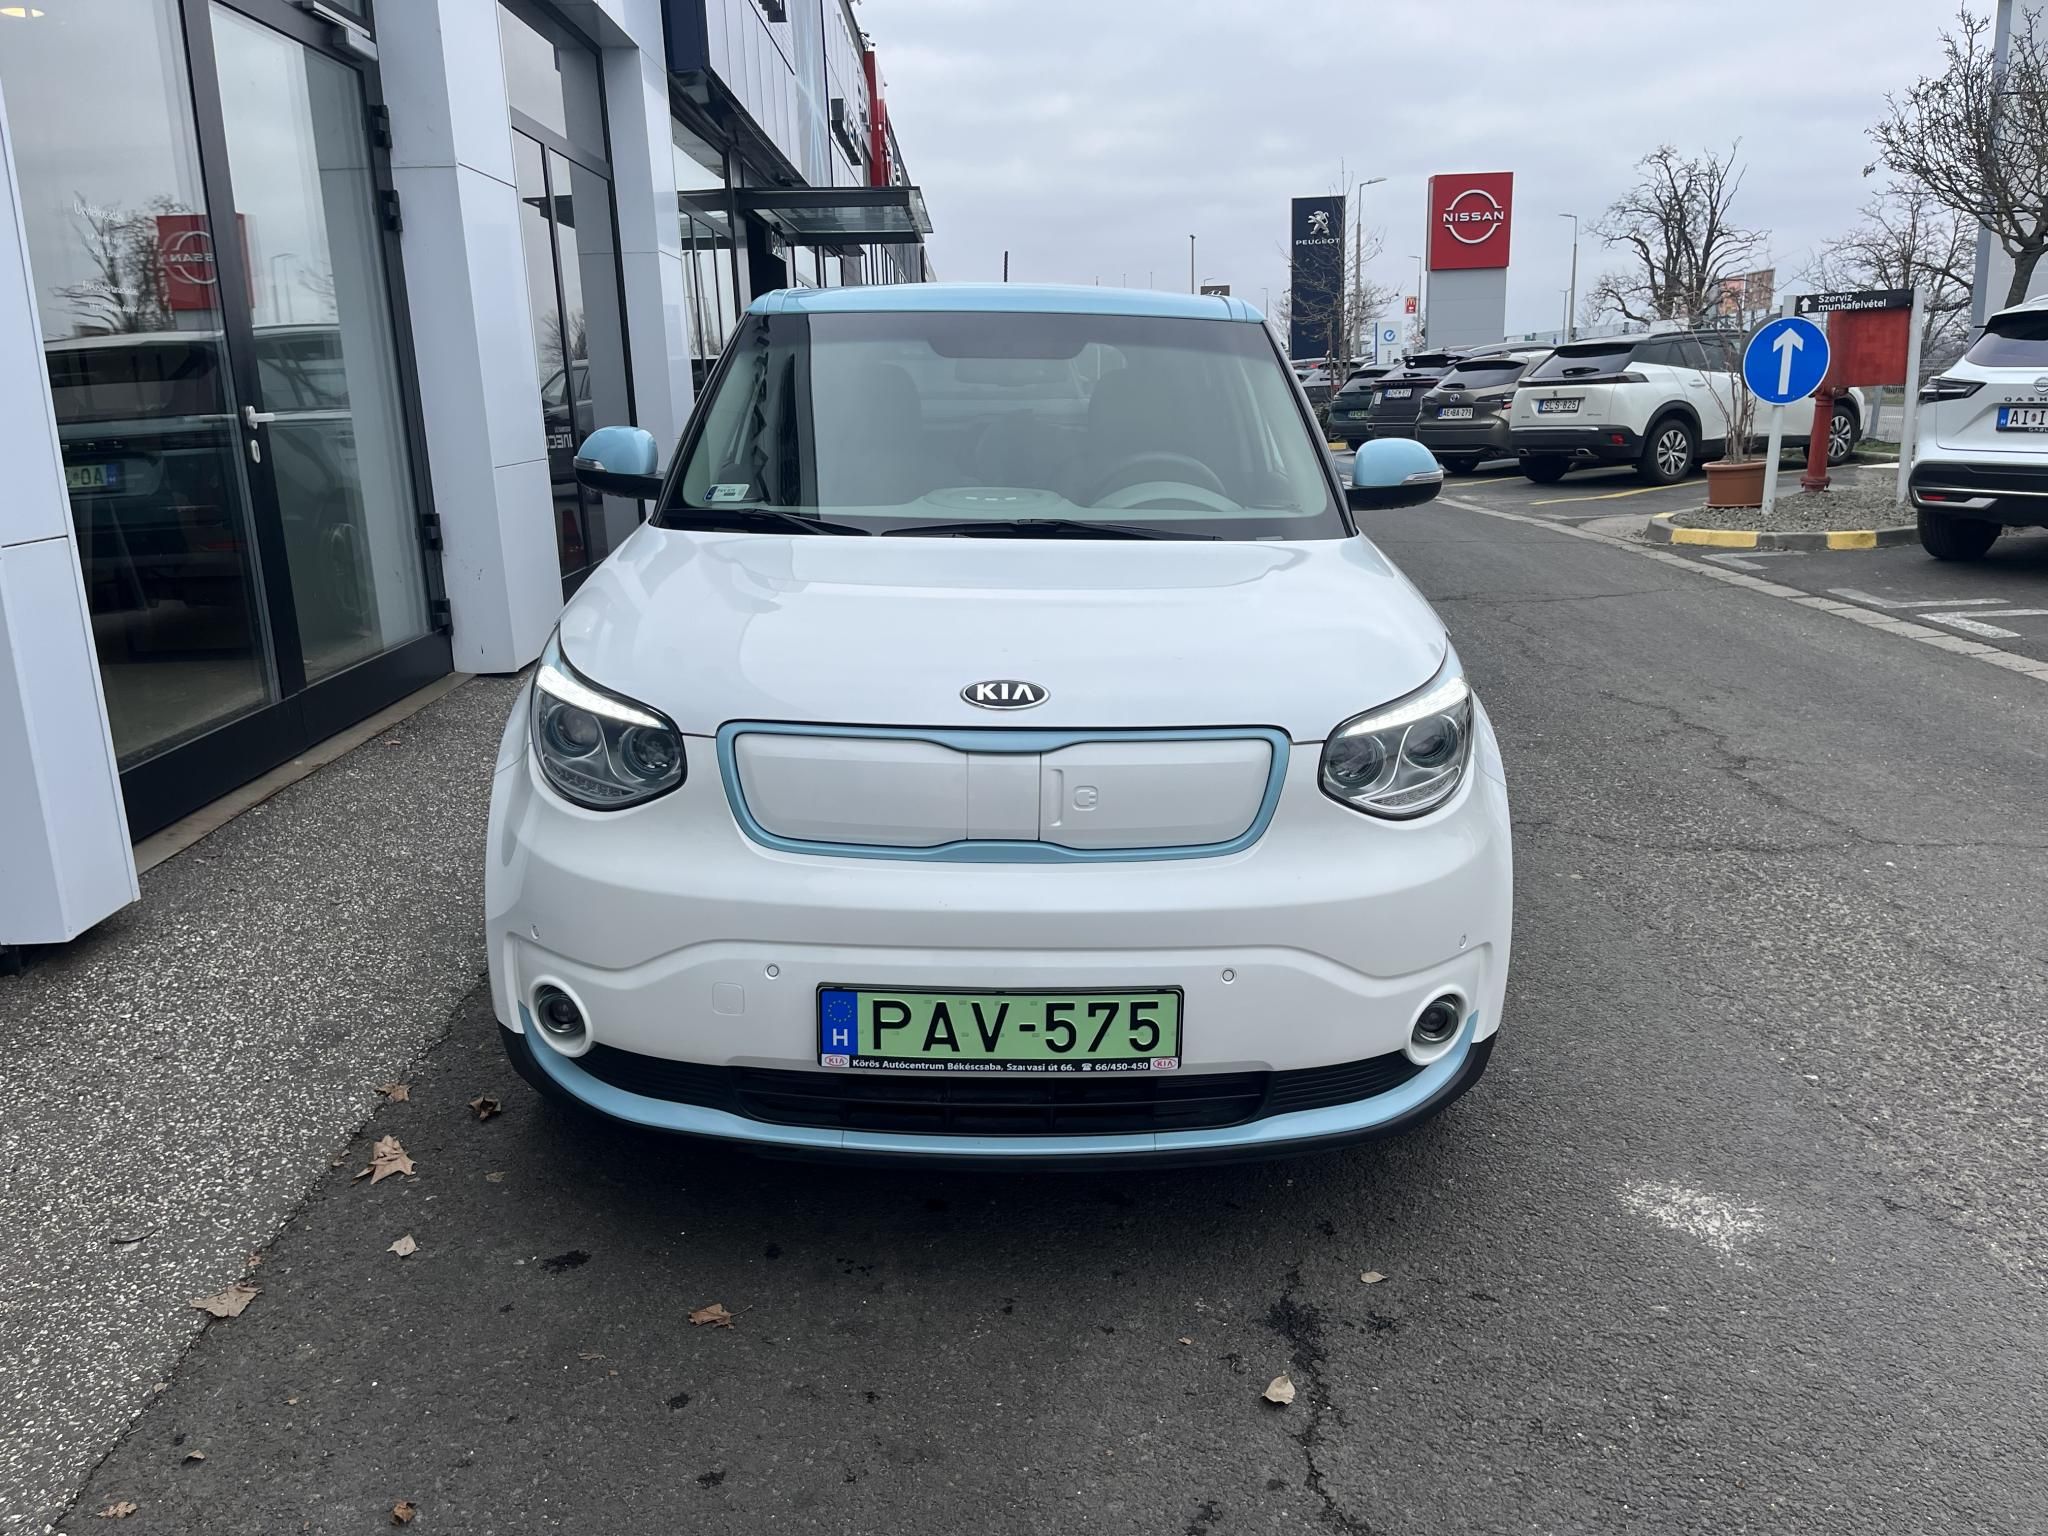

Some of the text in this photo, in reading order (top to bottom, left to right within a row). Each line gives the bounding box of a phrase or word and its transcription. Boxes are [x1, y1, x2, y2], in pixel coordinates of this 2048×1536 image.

[1443, 211, 1504, 222] NISSAN
[1295, 238, 1340, 246] PEUGEOT
[1818, 293, 1852, 303] Szerviz
[1818, 299, 1887, 311] munkafelvétel
[976, 683, 1035, 701] KIA
[833, 999, 1159, 1053] H PAV-575
[882, 1060, 945, 1070] Autócentrum
[1047, 1062, 1058, 1071] út
[1060, 1063, 1076, 1071] 66.
[1095, 1062, 1149, 1071] 66/450-450
